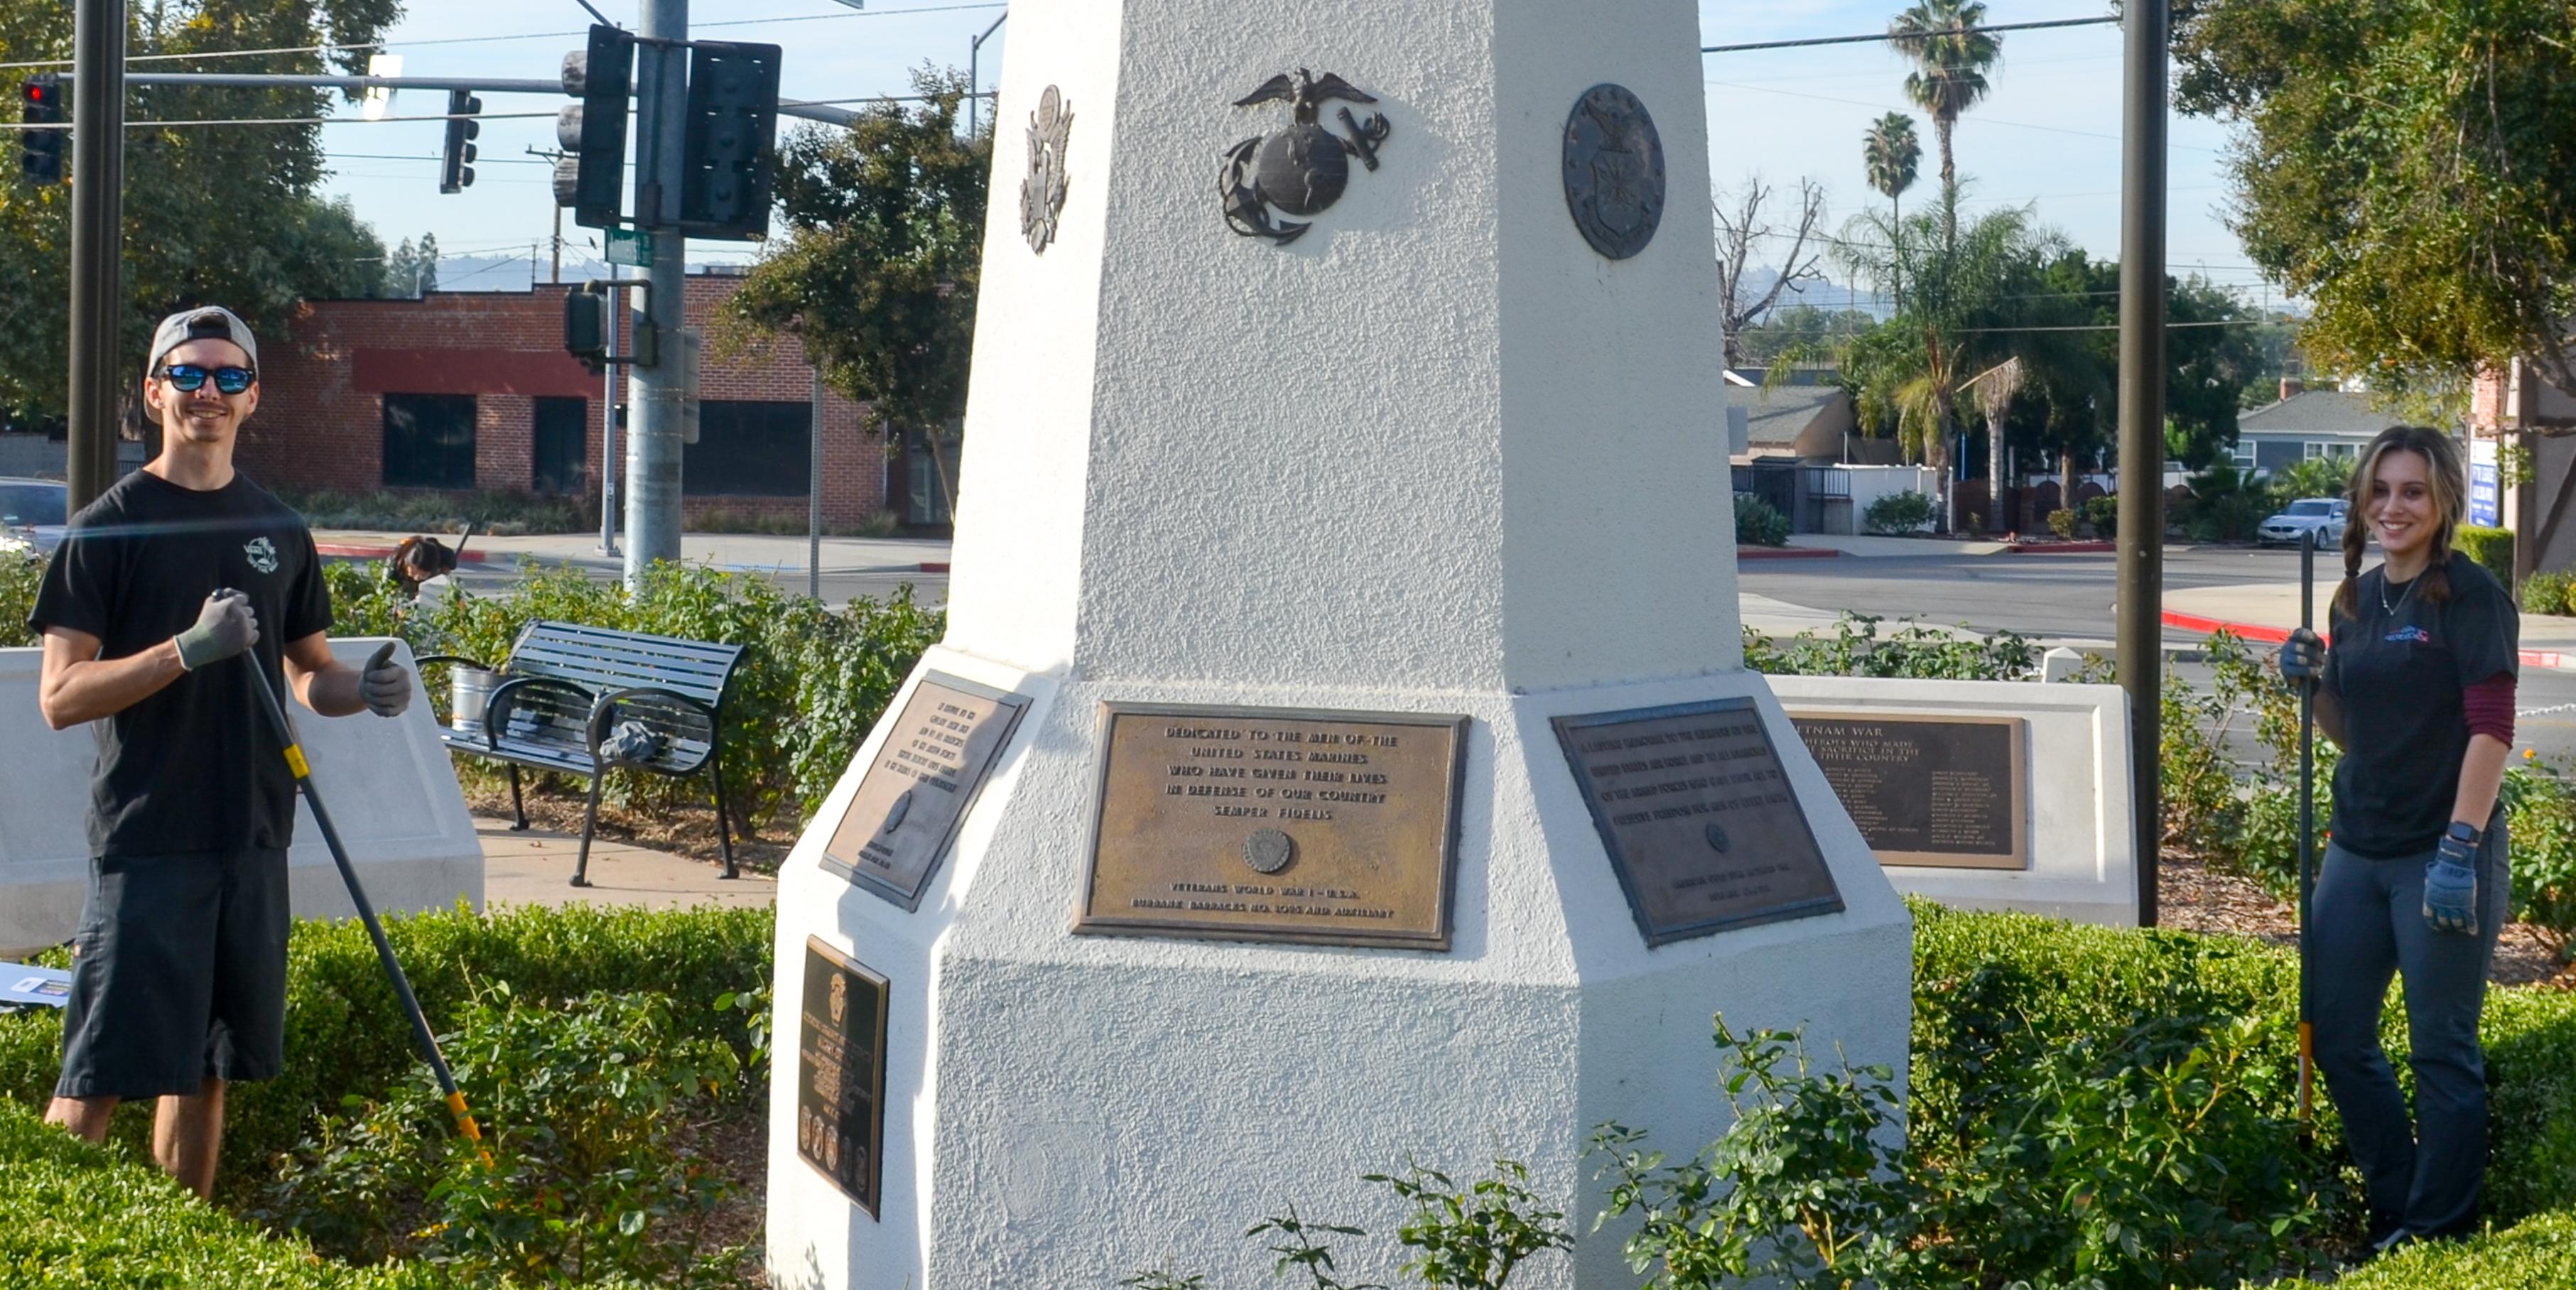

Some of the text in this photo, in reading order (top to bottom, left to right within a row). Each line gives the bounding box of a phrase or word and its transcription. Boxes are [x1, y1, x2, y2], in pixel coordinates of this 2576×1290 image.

[1164, 727, 1399, 747] DEDICATED TO THE MEN OF THE
[1852, 727, 1883, 737] WAR
[1191, 747, 1369, 764] UNITED STATES MARINES
[1167, 765, 1388, 784] WHO HAVE GIVEN THEIR LIVES
[1164, 784, 1387, 804] IN DEFENSE OF OUR COUNTRY
[1213, 805, 1332, 820] SEMPER FIDELIS
[1233, 884, 1275, 896] WORLD
[1279, 887, 1305, 897] WAR
